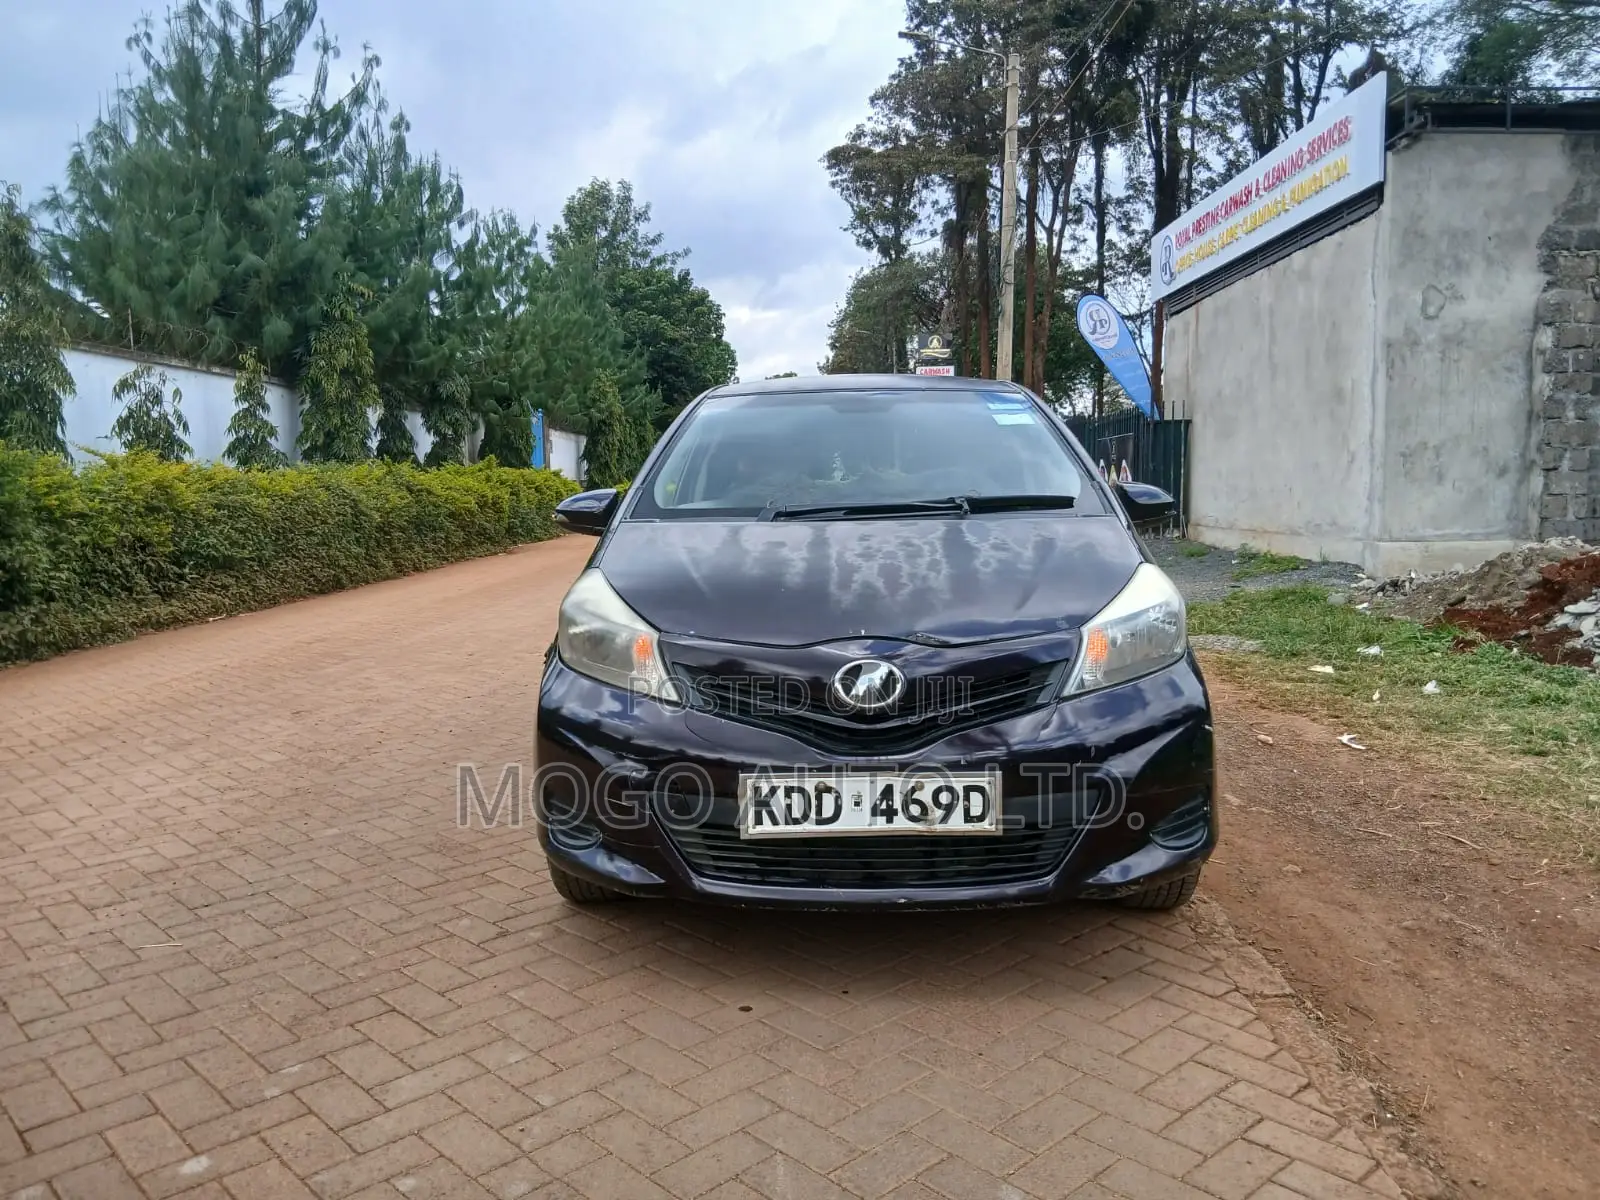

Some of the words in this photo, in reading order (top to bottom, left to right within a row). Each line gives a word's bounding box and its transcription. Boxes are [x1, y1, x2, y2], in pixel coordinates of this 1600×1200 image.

[1220, 182, 1253, 219] CARWASH
[1255, 178, 1263, 198] &
[1263, 147, 1304, 193] CLEANING
[1306, 115, 1352, 164] SERVICES
[753, 784, 843, 826] KDD
[870, 783, 991, 825] 469D
